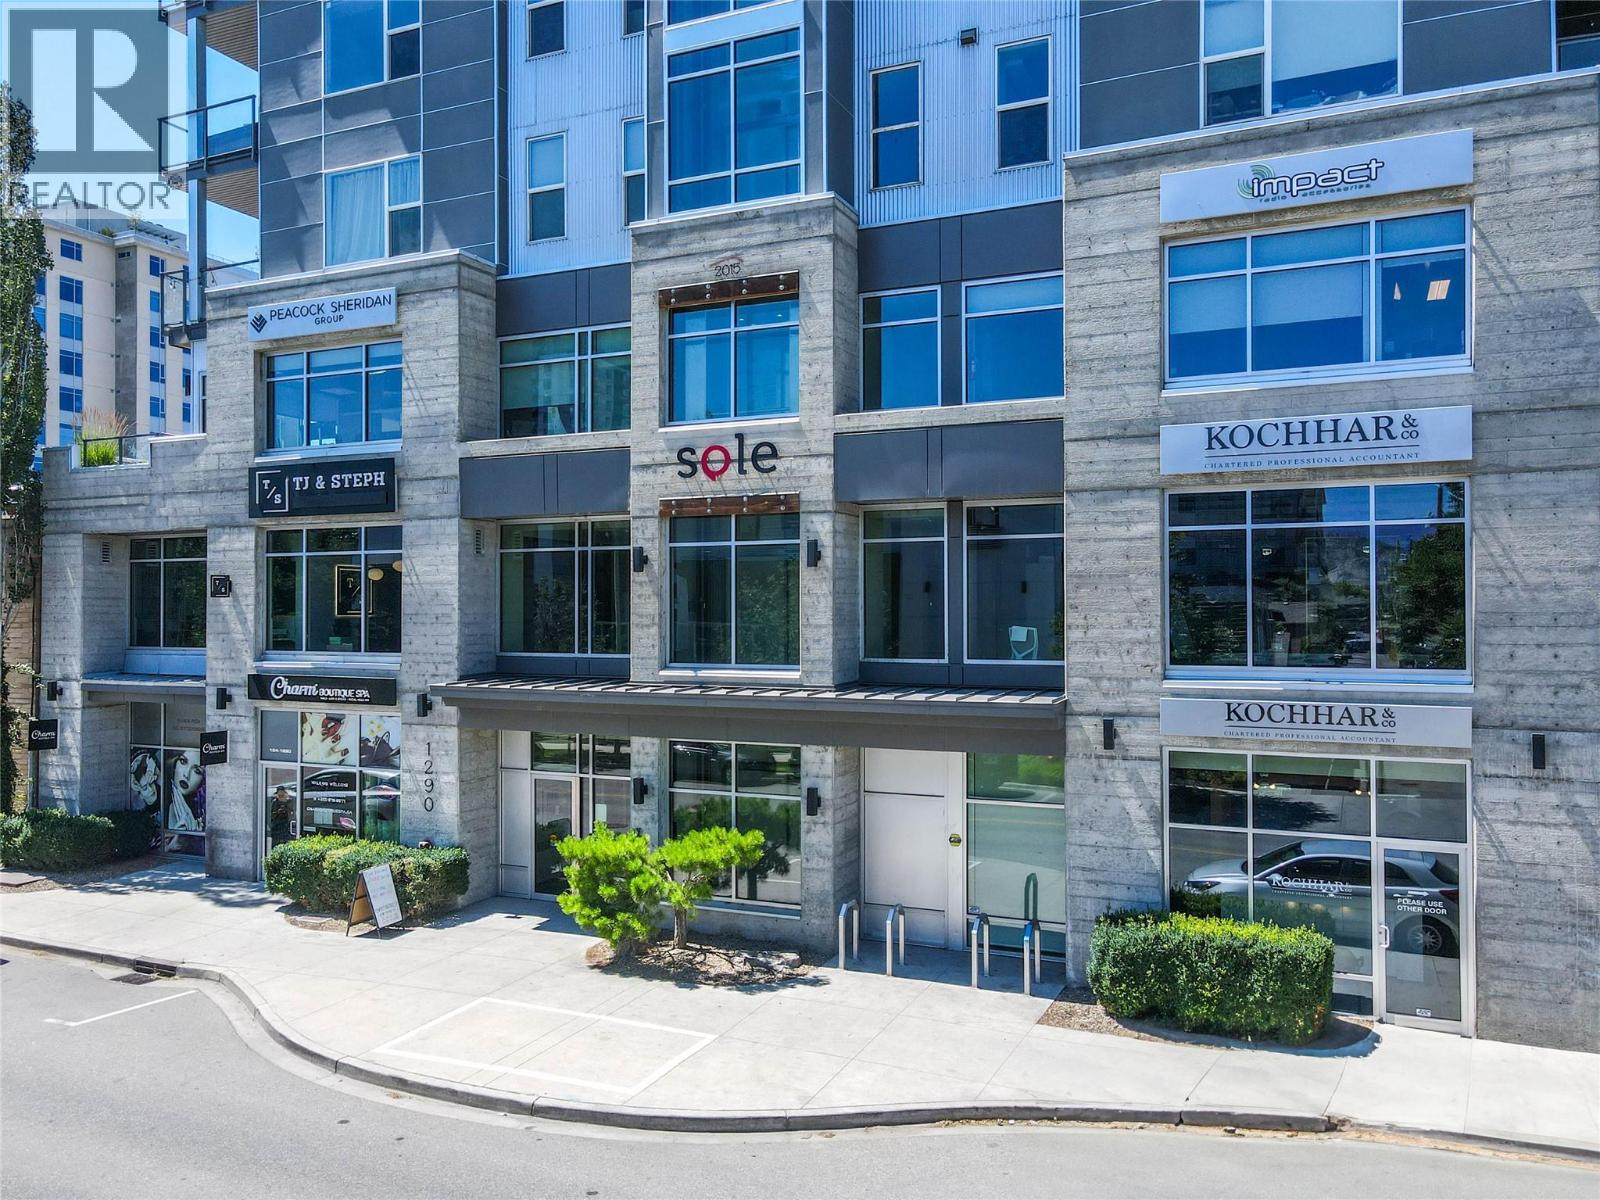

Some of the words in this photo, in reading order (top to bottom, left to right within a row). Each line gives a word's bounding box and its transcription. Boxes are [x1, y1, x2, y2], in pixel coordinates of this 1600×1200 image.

[1252, 158, 1385, 198] impact
[714, 263, 741, 277] 2015
[269, 302, 325, 321] PEACOCK
[330, 294, 392, 313] SHERIDAN
[314, 314, 344, 325] GROUP
[1401, 413, 1418, 428] &
[1204, 415, 1398, 450] KOCHHAR
[1401, 430, 1419, 440] CO
[677, 432, 779, 481] sole
[1204, 460, 1263, 469] CHARTERED
[1267, 456, 1344, 467] PROFESSIONAL
[1349, 452, 1420, 463] ACCOUNTANT
[293, 475, 310, 490] TJ
[315, 475, 326, 489] &
[331, 471, 386, 489] STEPH
[270, 676, 318, 699] Charm
[319, 688, 355, 698] BOUTIQUE
[355, 689, 370, 698] SPA
[1224, 702, 1379, 727] KOCHHAR
[1382, 707, 1396, 719] &
[1381, 719, 1396, 728] CO
[1223, 730, 1271, 738] CHARTERED
[1274, 732, 1336, 741] PROFESSIONAL
[1340, 735, 1396, 743] ACCOUNTANT
[424, 742, 434, 812] 1290
[1396, 904, 1423, 913] OTHER
[1424, 907, 1447, 915] DOOR
[1397, 898, 1426, 907] PLEASE
